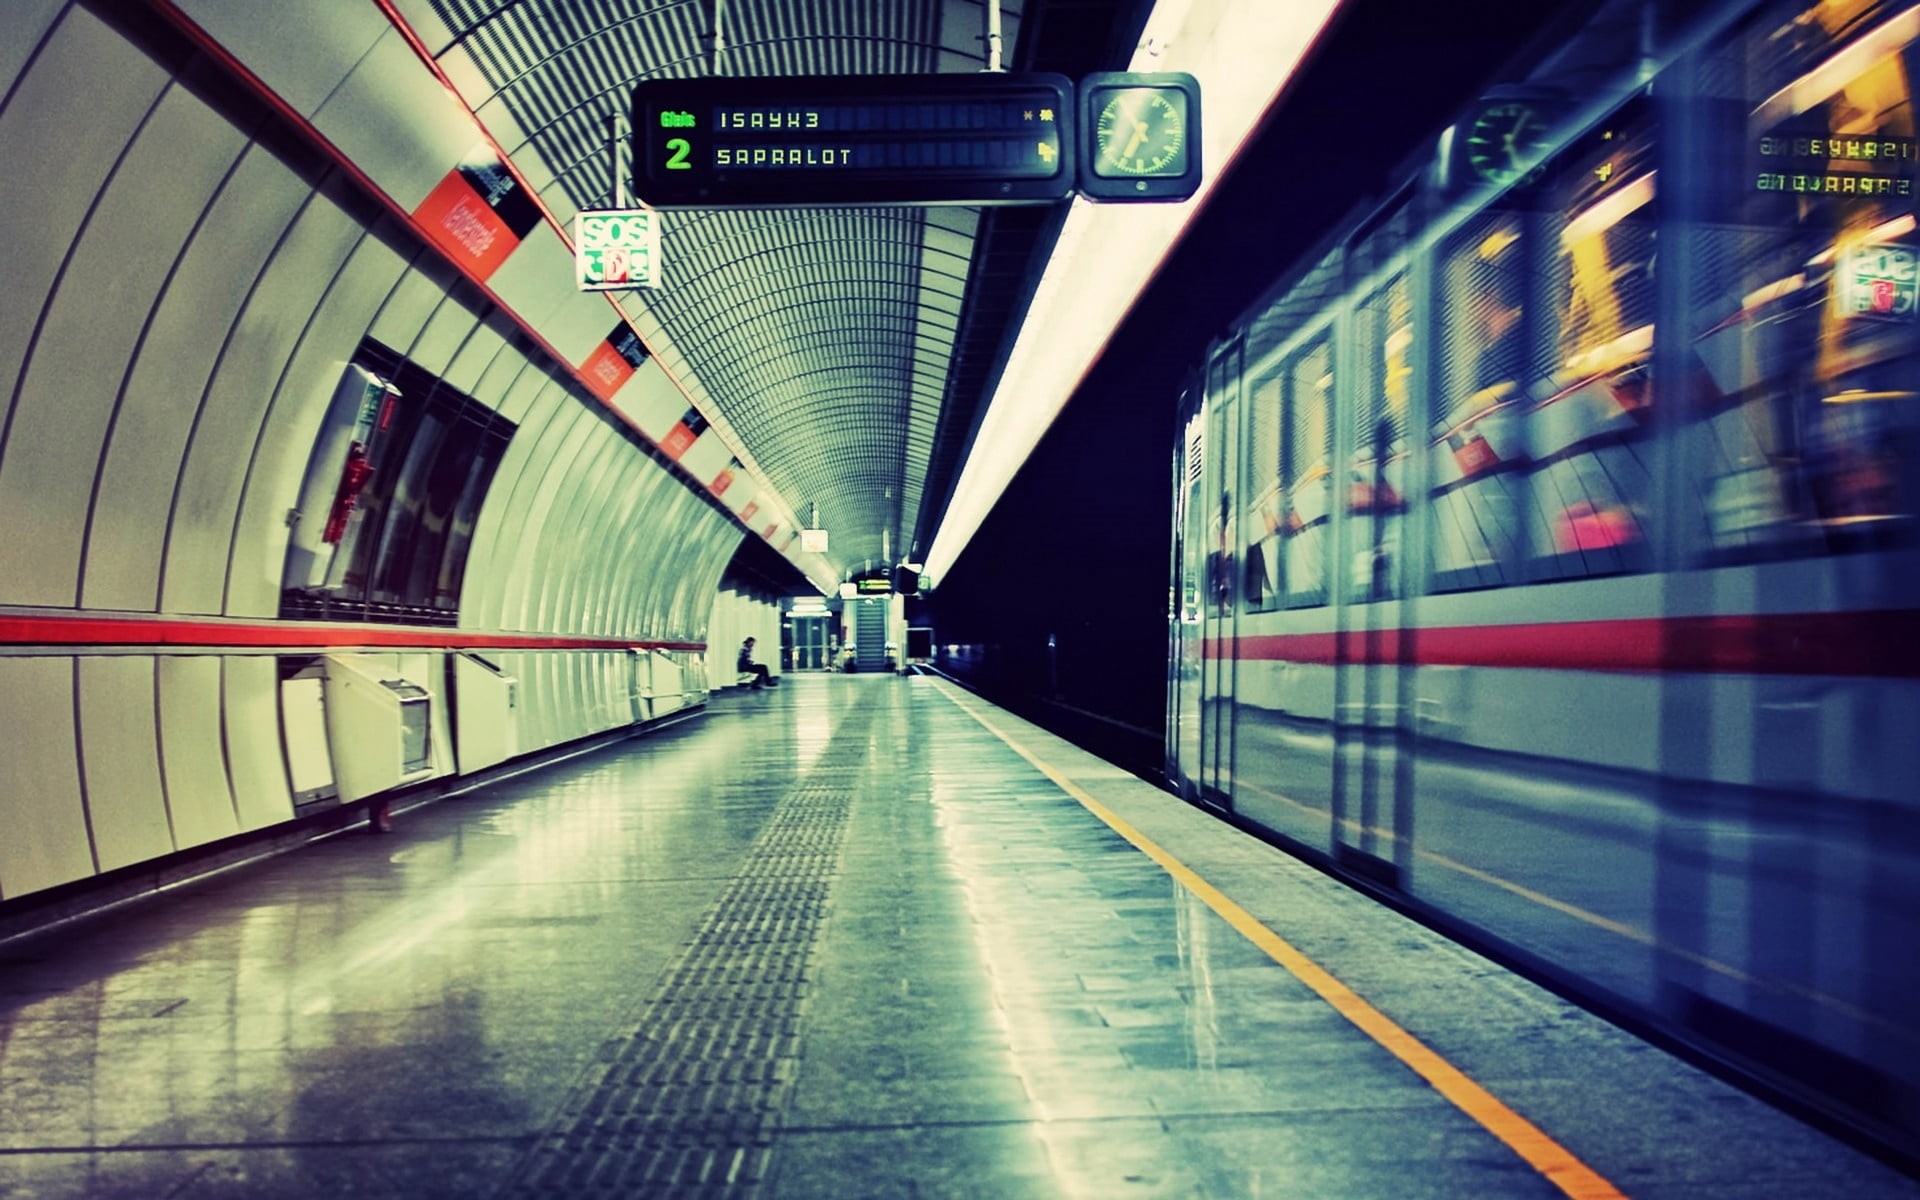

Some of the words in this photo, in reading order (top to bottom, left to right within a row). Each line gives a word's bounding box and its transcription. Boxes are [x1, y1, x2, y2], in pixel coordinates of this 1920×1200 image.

[665, 138, 692, 170] 2
[717, 148, 851, 165] SAPRALOT
[584, 217, 648, 249] SOS
